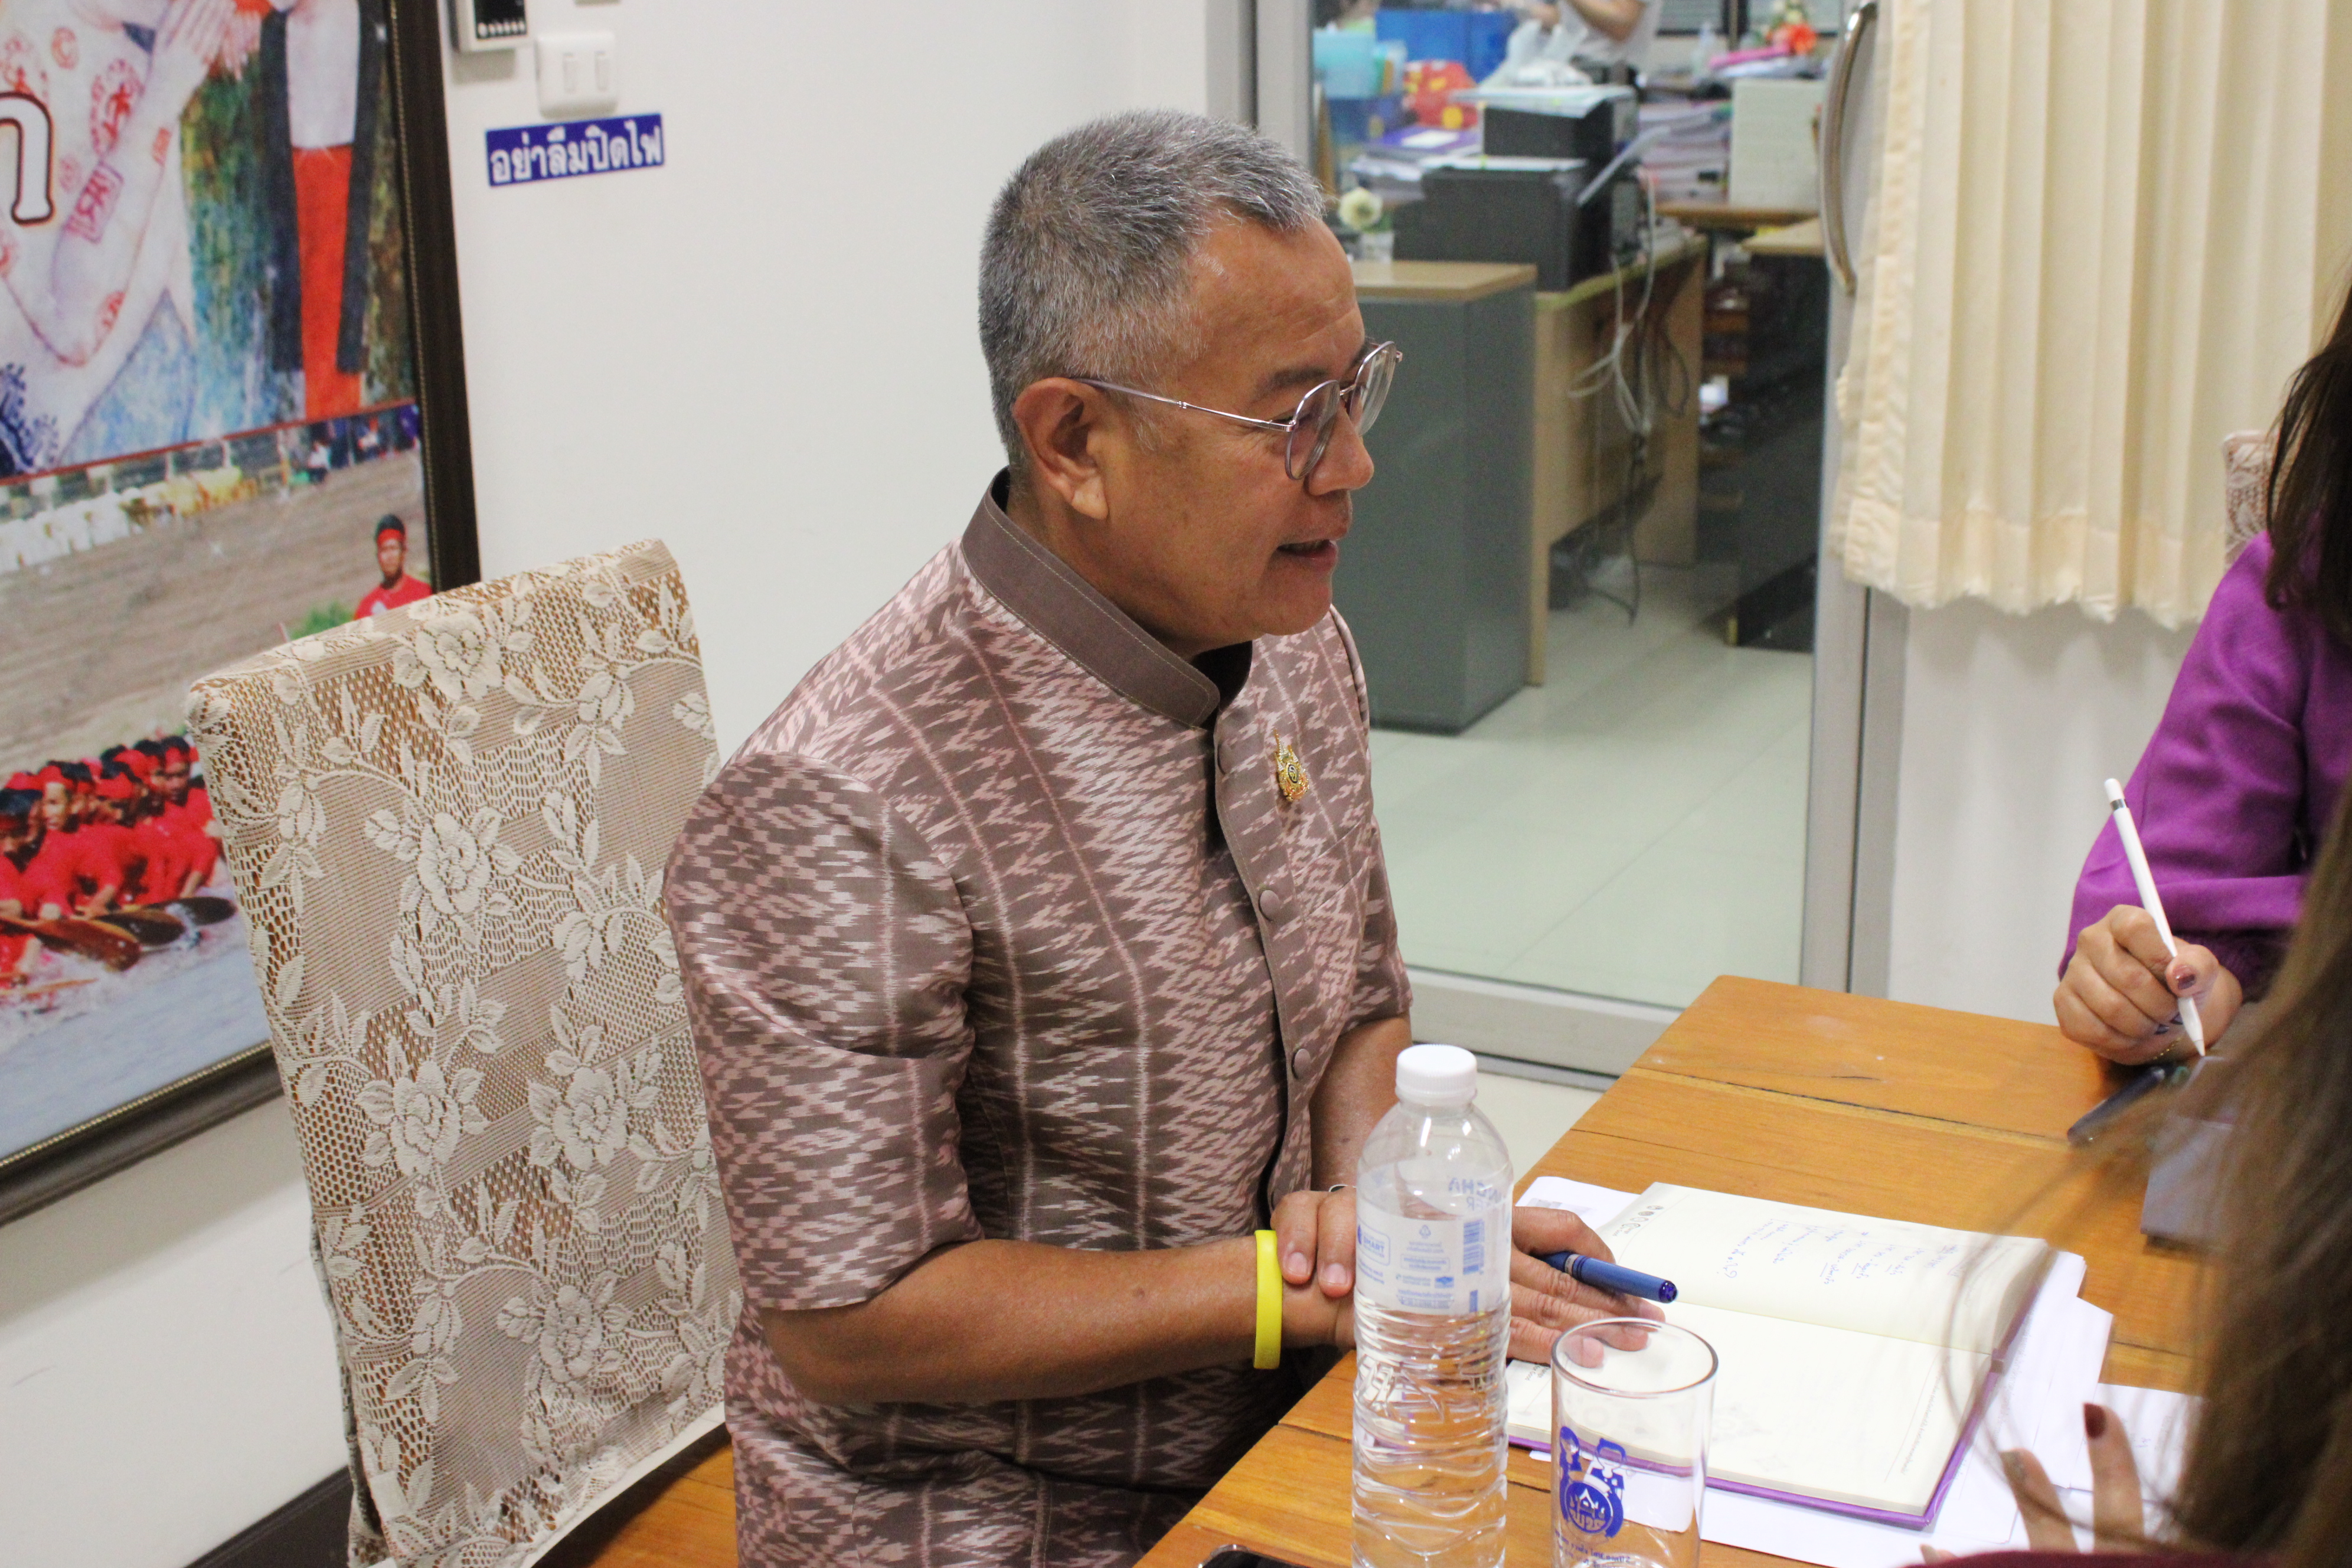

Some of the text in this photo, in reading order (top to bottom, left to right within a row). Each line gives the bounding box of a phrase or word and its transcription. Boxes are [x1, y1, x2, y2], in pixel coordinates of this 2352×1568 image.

[489, 120, 662, 184] อย่าลืมปิดไฟ
